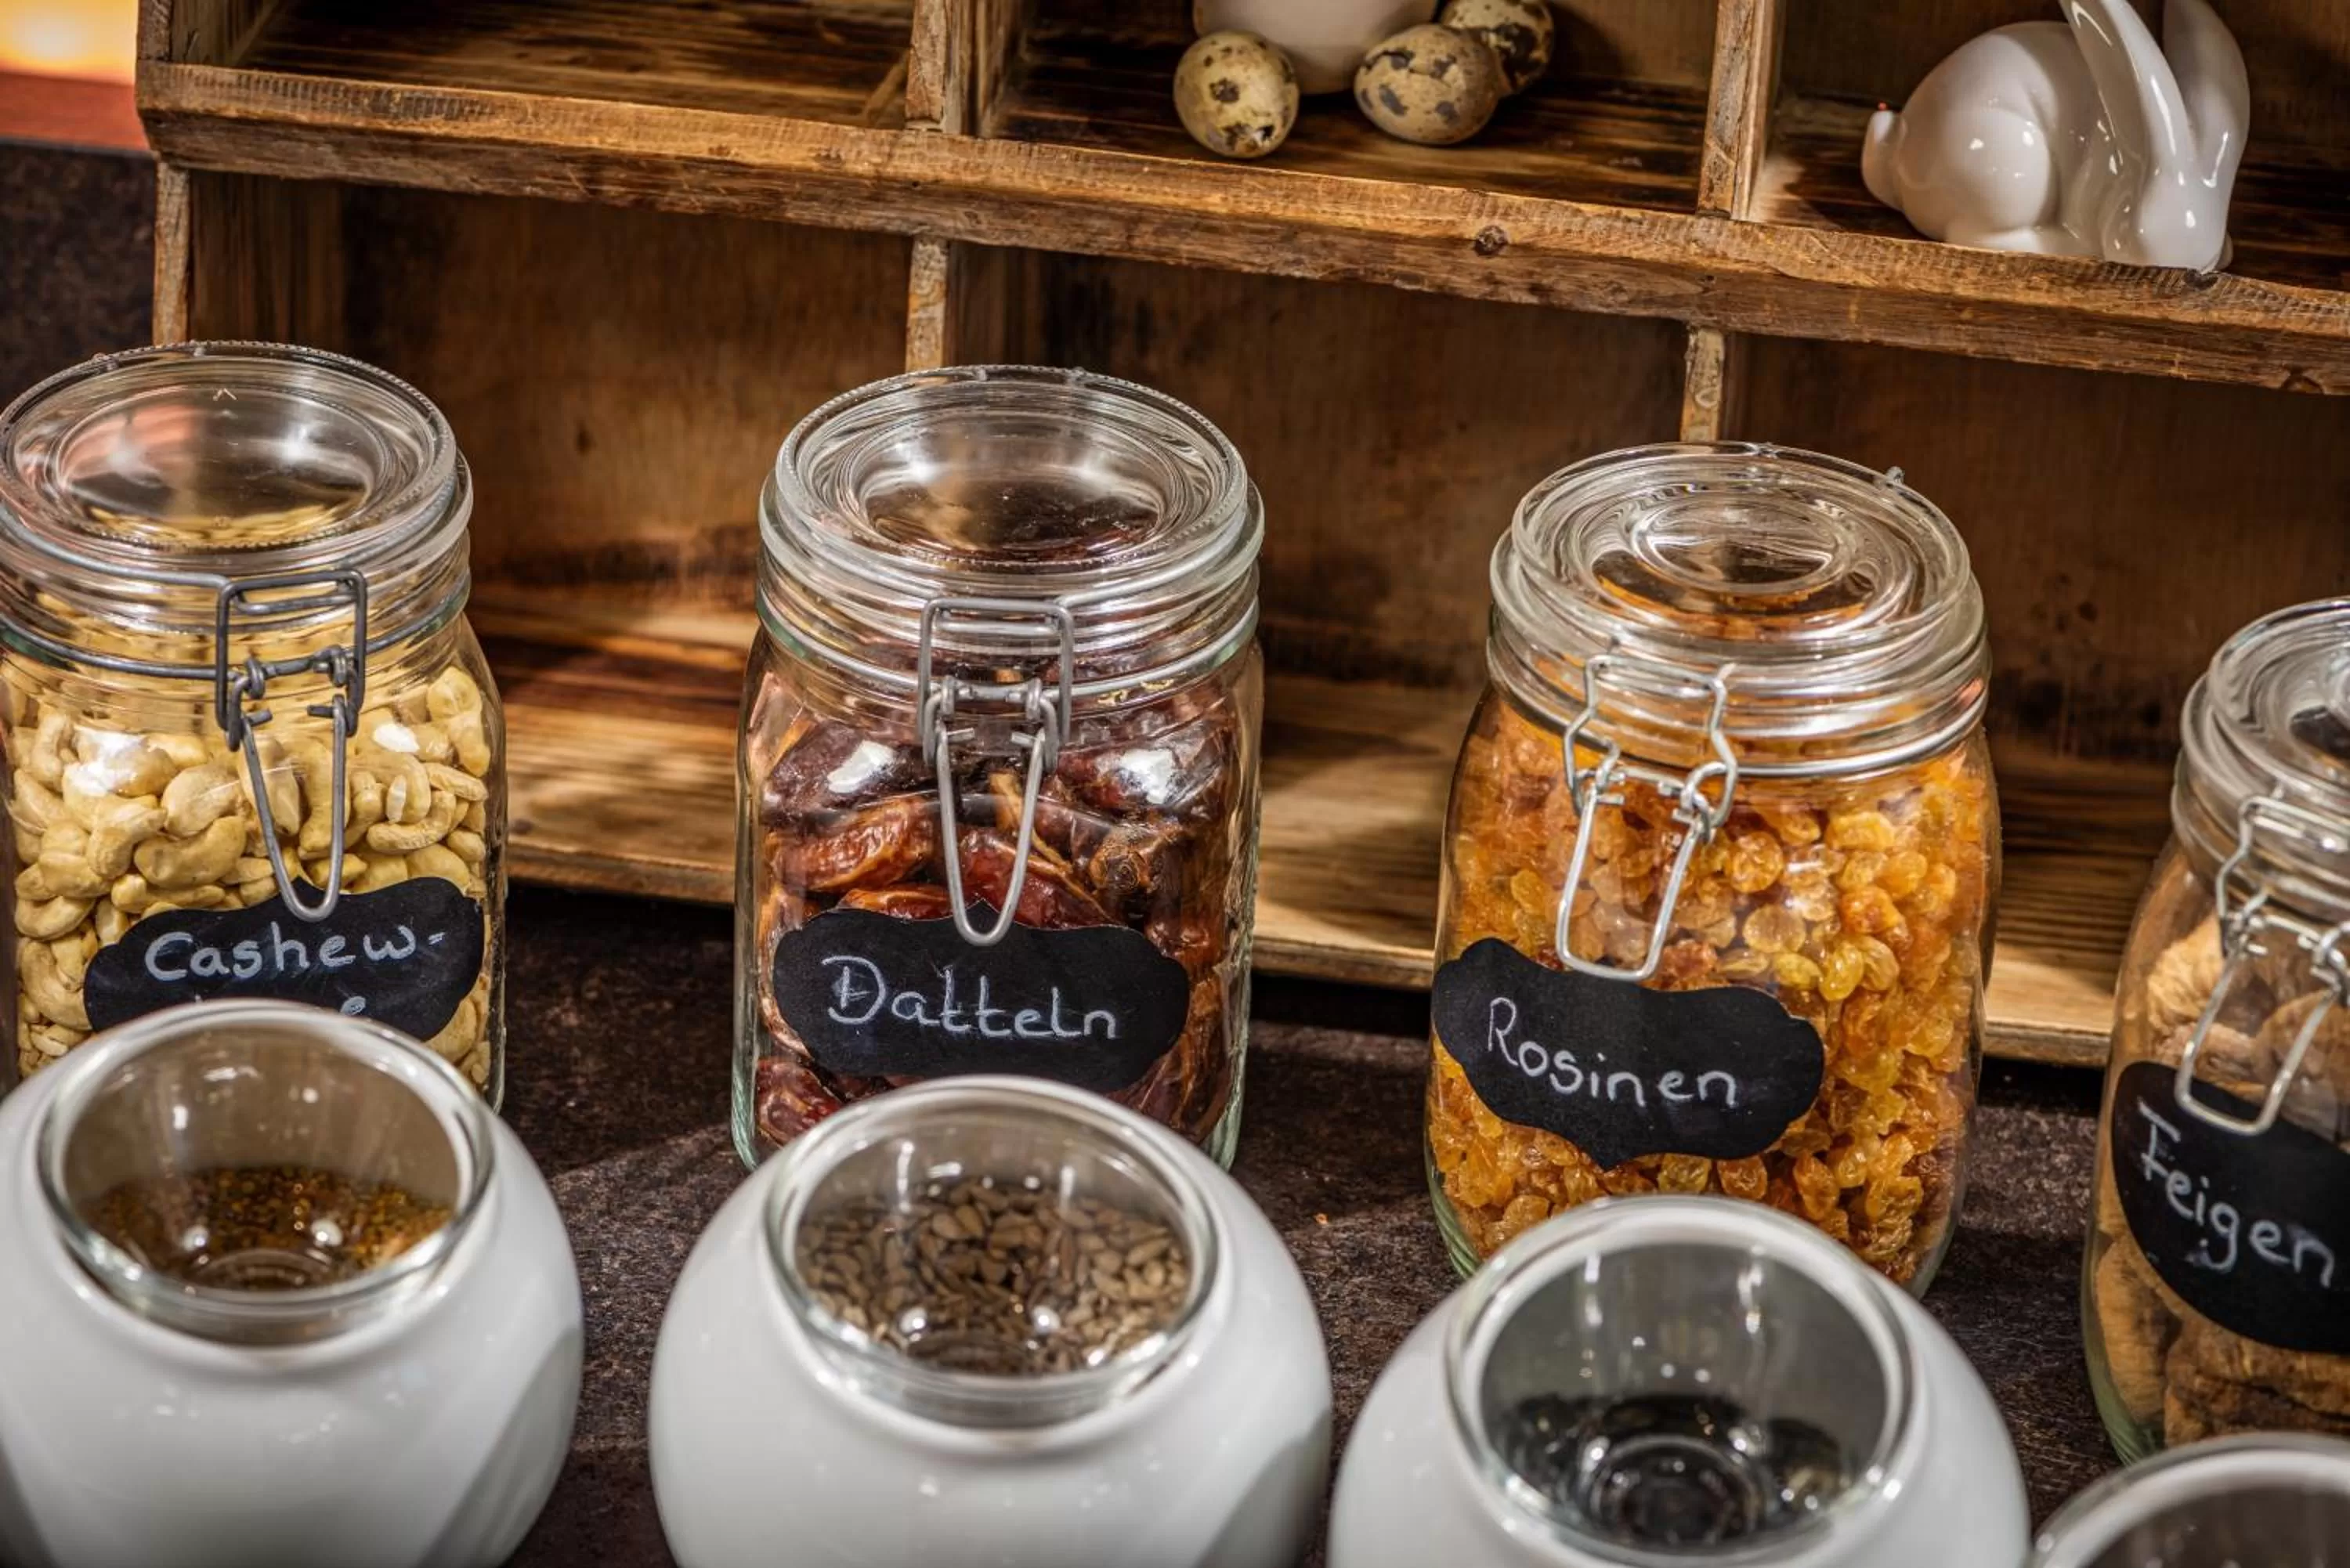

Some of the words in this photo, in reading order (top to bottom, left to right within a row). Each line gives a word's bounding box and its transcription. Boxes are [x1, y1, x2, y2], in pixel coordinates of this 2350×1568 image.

[144, 921, 445, 981] Cashew-
[821, 955, 1118, 1040] Datteln
[1488, 996, 1737, 1108] Rosinen
[2138, 1098, 2335, 1288] Feigen
